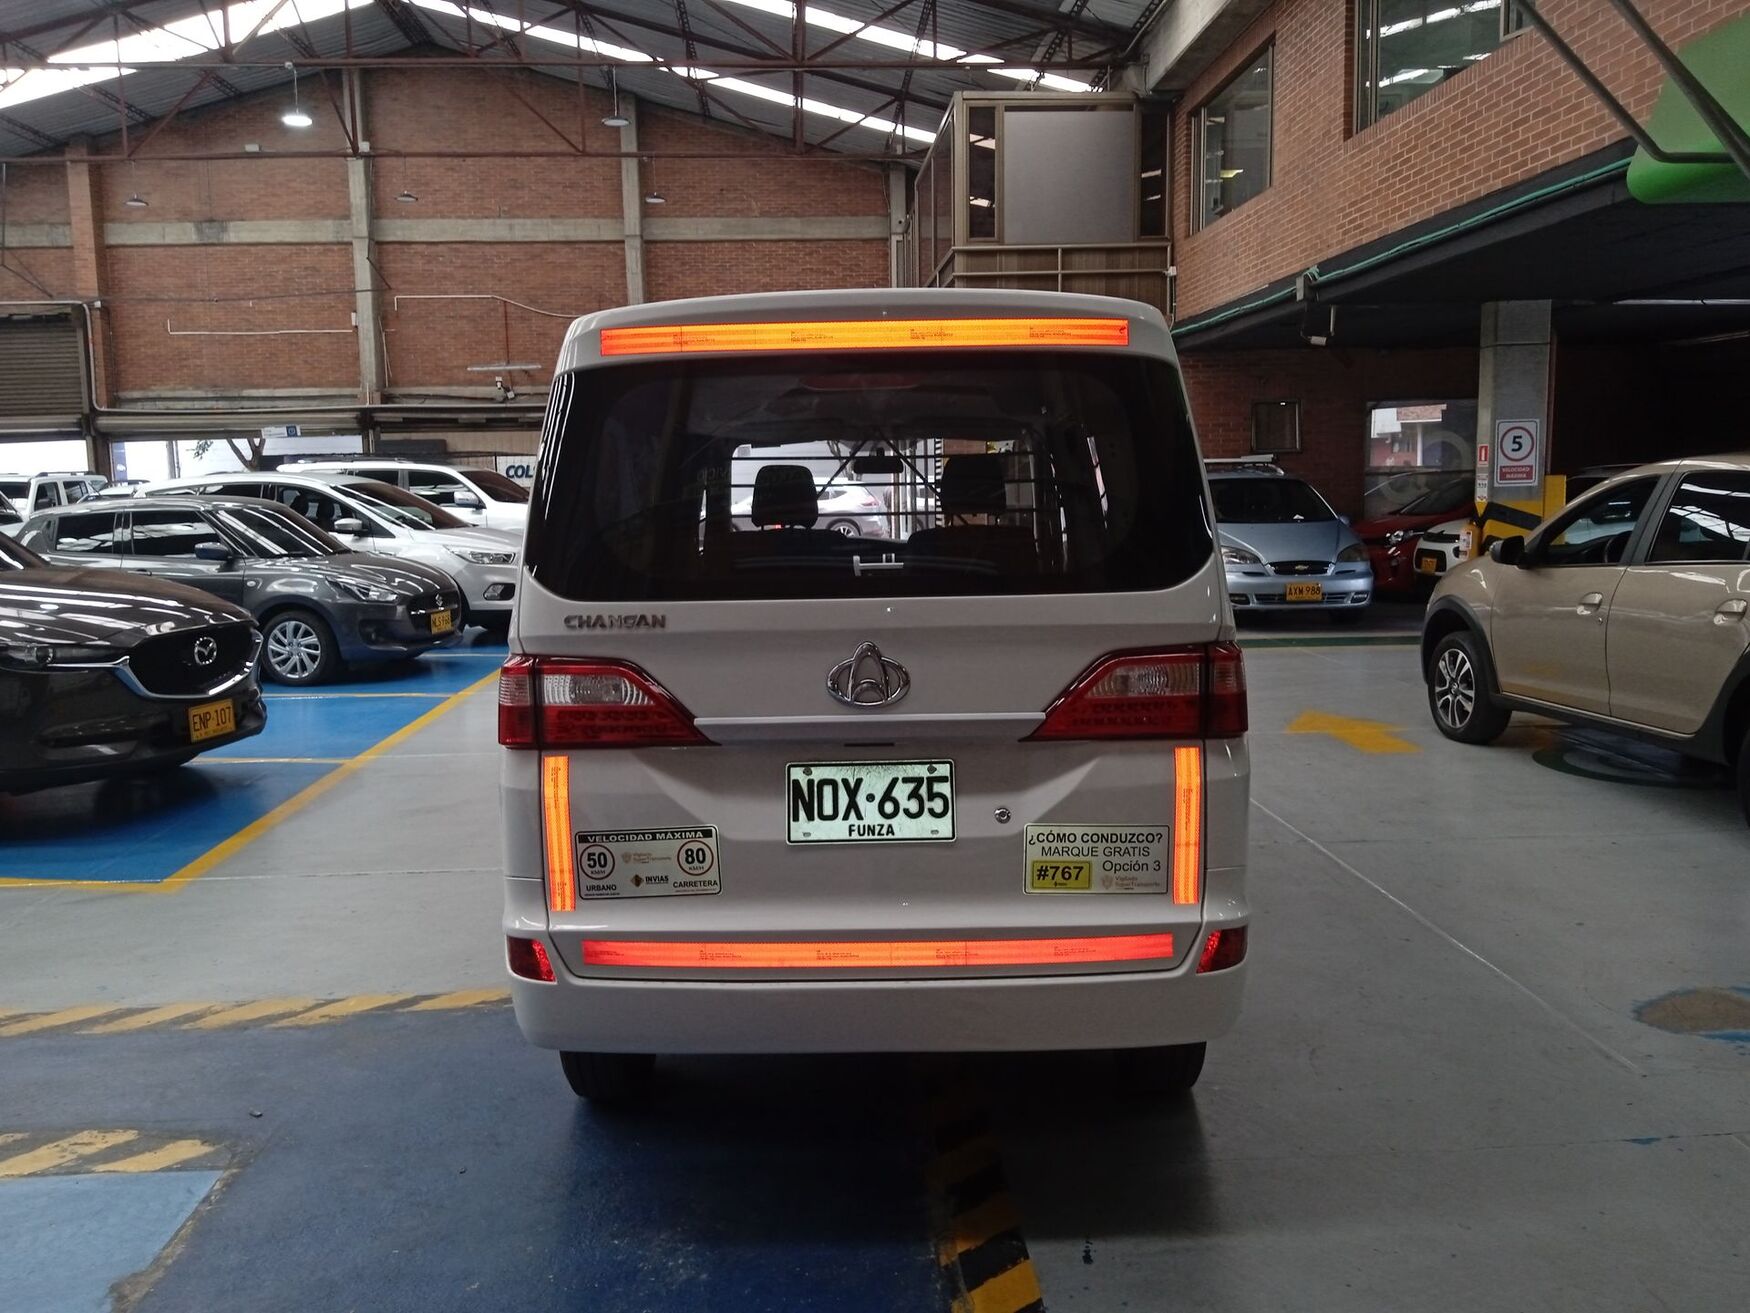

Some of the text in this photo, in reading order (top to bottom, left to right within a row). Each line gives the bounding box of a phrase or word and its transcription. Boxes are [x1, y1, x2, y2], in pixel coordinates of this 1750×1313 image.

[1511, 435, 1523, 452] 5
[505, 464, 537, 478] COL
[587, 831, 704, 843] VELOCIDAD MÁXIMA
[848, 823, 895, 837] FUNZA
[1028, 830, 1163, 845] ¿CÓMO CONDUZCO?
[684, 847, 707, 865] 80
[1041, 846, 1151, 857] MARQUE GRATIS
[586, 852, 608, 869] 50
[1102, 859, 1162, 874] Opción 3
[1036, 865, 1084, 881] #767
[586, 884, 617, 892] URBANO
[672, 880, 719, 889] CARRETERA
